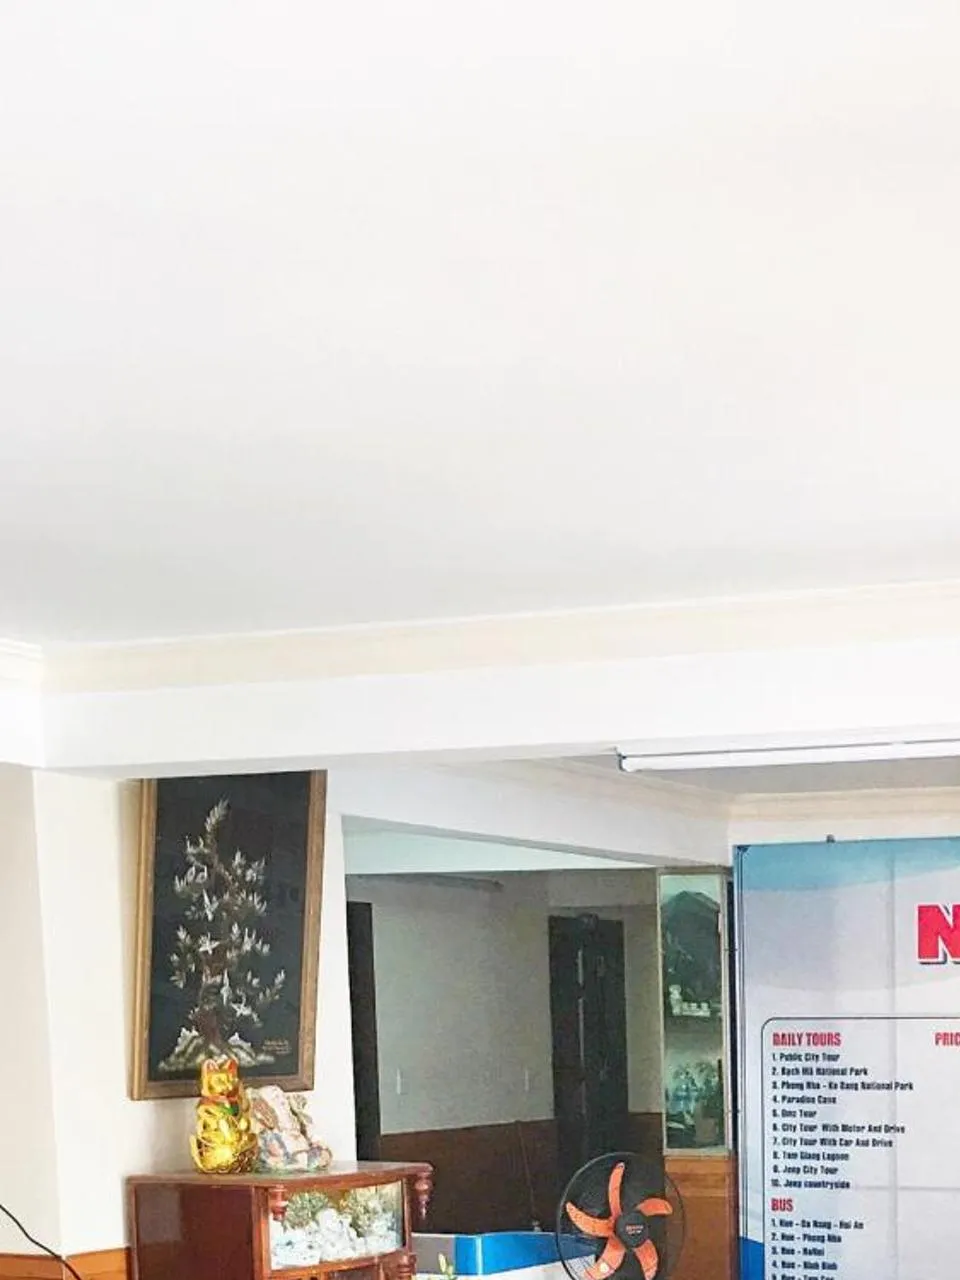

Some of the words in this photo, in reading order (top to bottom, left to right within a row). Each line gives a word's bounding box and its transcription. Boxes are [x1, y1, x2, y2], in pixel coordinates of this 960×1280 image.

[772, 1032, 803, 1046] DAILY
[806, 1032, 841, 1047] TOURS
[780, 1053, 802, 1062] Public
[804, 1053, 820, 1063] City
[822, 1053, 840, 1062] Tour
[815, 1067, 847, 1076] National
[849, 1067, 868, 1076] Park
[781, 1081, 804, 1090] Phong
[860, 1081, 893, 1091] National
[894, 1082, 913, 1091] Park
[799, 1109, 817, 1118] Tour
[781, 1123, 797, 1132] City
[799, 1123, 817, 1132] Tour
[822, 1124, 839, 1132] With
[868, 1124, 882, 1133] And
[781, 1137, 797, 1146] City
[799, 1137, 817, 1146] Tour
[819, 1138, 837, 1146] With
[839, 1138, 853, 1146] Car
[855, 1138, 870, 1147] And
[822, 1152, 849, 1161] Lagoon
[783, 1165, 801, 1174] Jeep
[803, 1165, 818, 1174] City
[820, 1165, 839, 1174] Tour
[804, 1180, 850, 1189] countryside
[771, 1198, 793, 1211] BUS
